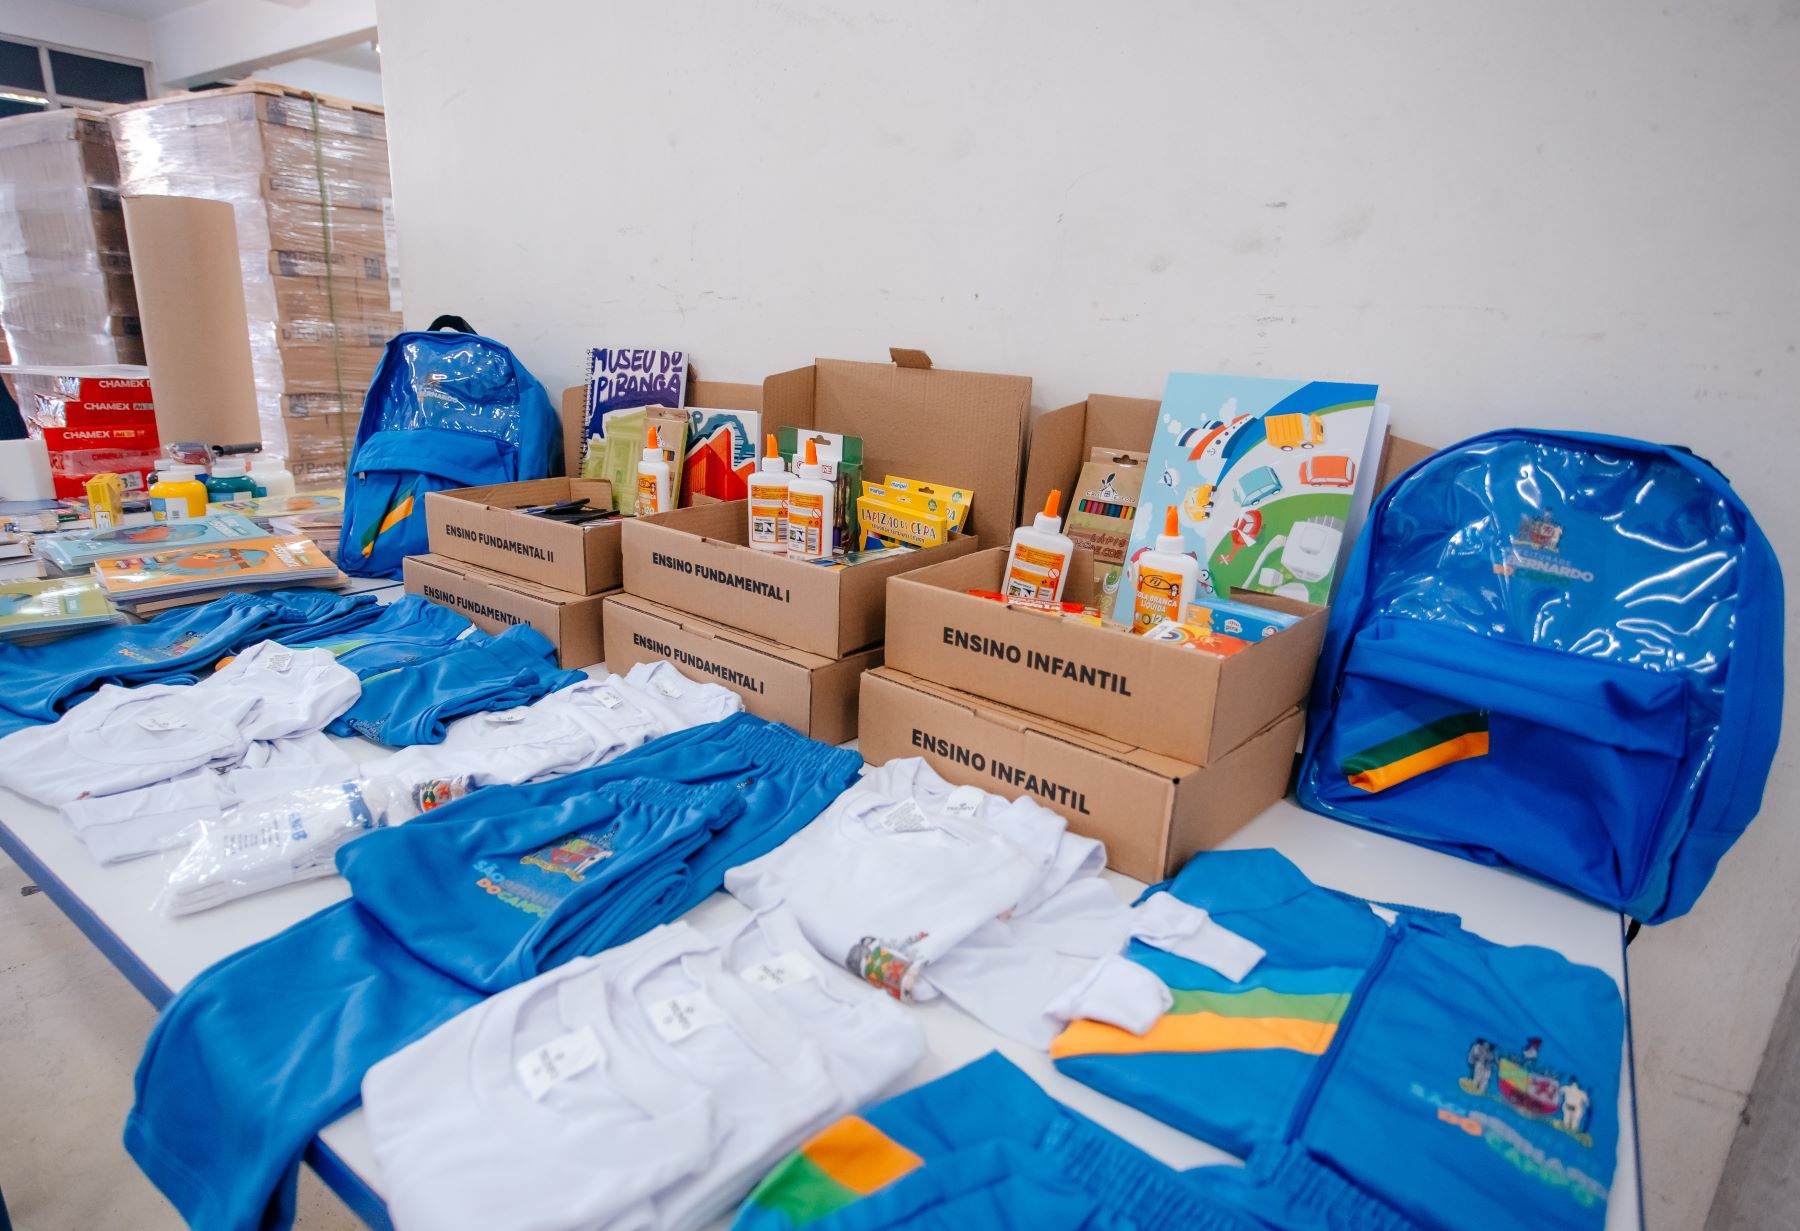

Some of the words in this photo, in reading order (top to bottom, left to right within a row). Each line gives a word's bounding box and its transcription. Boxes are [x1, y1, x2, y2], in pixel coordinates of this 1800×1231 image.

[592, 348, 656, 373] MUSEU
[660, 351, 682, 374] DO
[98, 380, 144, 388] CHAMEX
[83, 402, 130, 410] CHAMEX
[63, 431, 110, 439] CHAMEX
[910, 522, 936, 539] CERA
[446, 524, 477, 542] ENSINO
[478, 532, 545, 561] FUNDAMENTAL
[547, 550, 554, 563] II
[652, 552, 692, 574] ENSINO
[695, 564, 784, 600] FUNDAMENTAL
[423, 585, 455, 605] ENSINO
[1149, 594, 1177, 607] BRANCA
[1141, 600, 1166, 612] LÍQUIDA
[633, 632, 671, 657] ENSINO
[674, 647, 758, 691] FUNDAMENTAL
[943, 626, 1021, 664] ENSINO
[1026, 650, 1131, 697] INFANTIL
[912, 728, 986, 772] ENSINO
[991, 759, 1090, 815] INFANTIL
